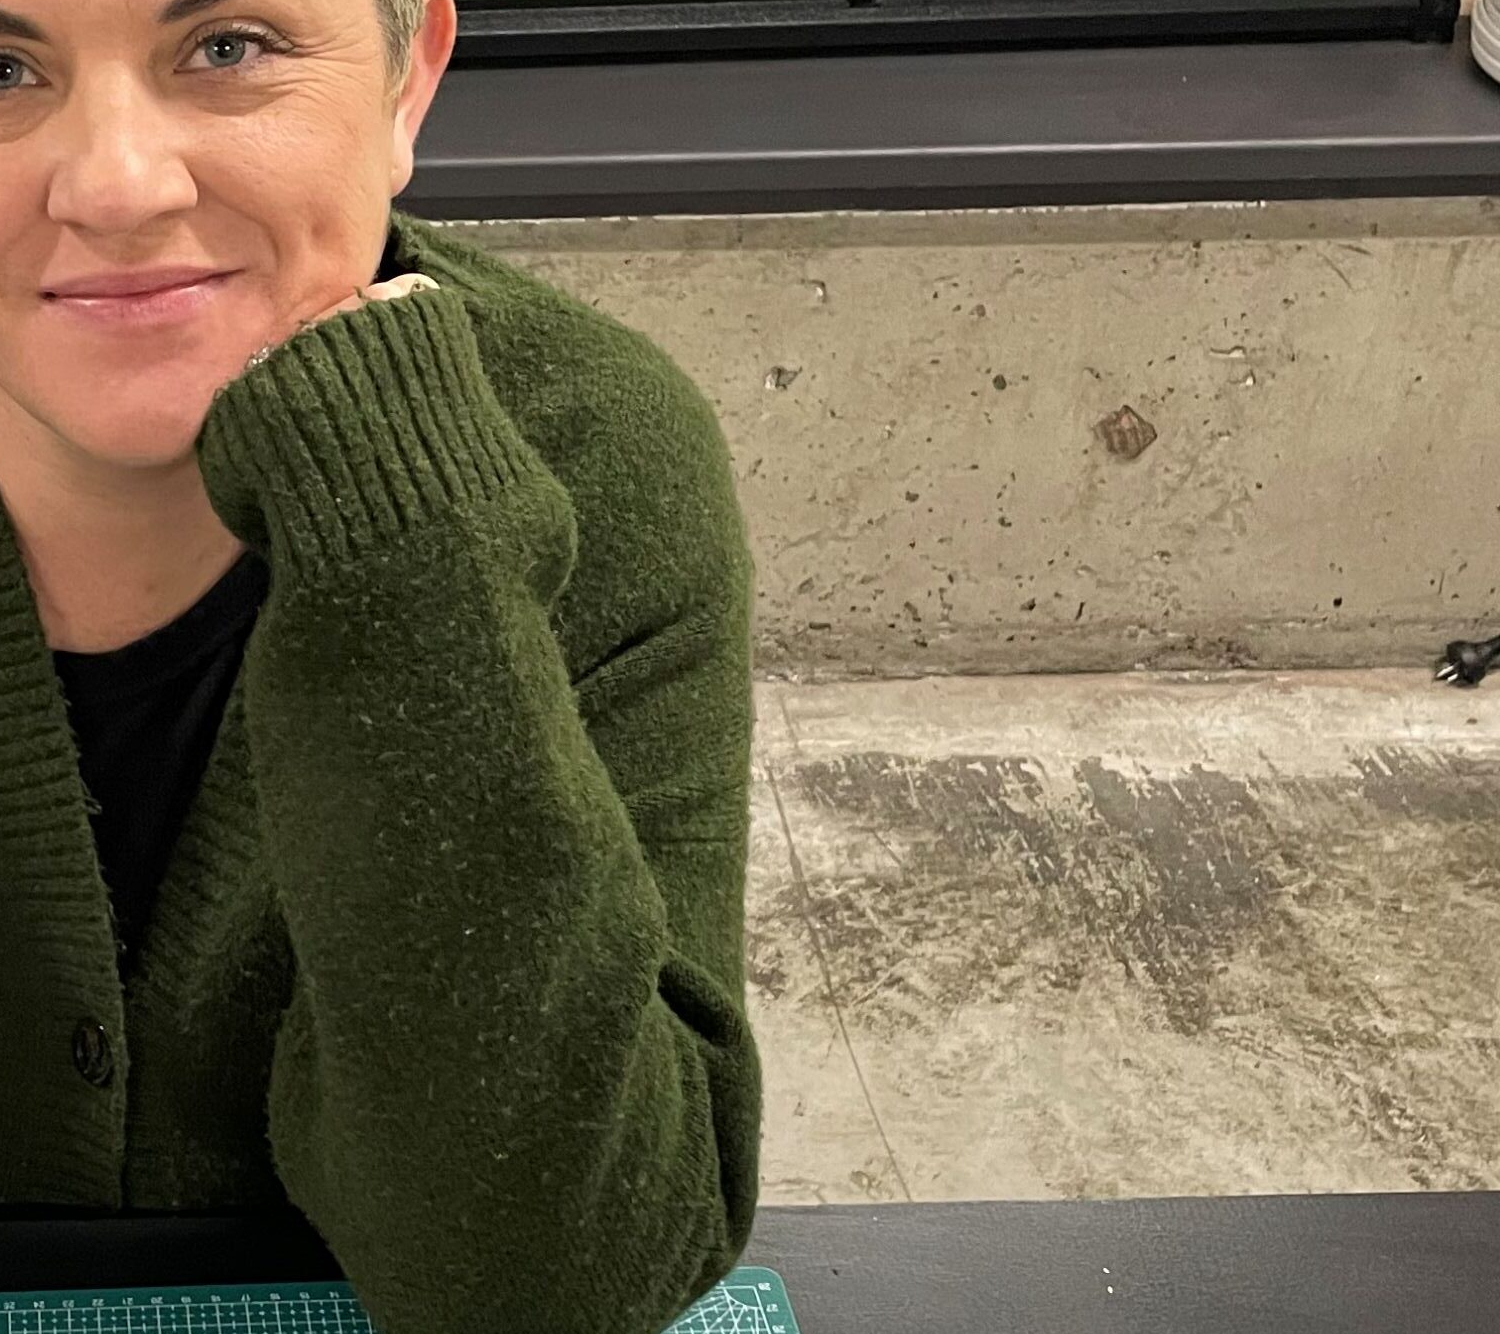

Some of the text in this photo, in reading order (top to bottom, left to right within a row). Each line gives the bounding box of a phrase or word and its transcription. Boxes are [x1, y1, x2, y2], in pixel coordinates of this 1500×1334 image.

[758, 1283, 770, 1291] 28
[210, 1294, 221, 1302] 18
[241, 1293, 250, 1301] 17
[269, 1293, 280, 1301] 16
[299, 1291, 310, 1300] 15
[329, 1291, 340, 1299] 14
[62, 1299, 74, 1307] 23
[92, 1299, 104, 1307] 22
[122, 1297, 133, 1305] 21
[151, 1296, 163, 1304] 20
[181, 1295, 191, 1304] 19
[33, 1300, 44, 1308] 24
[766, 1303, 778, 1312] 27
[772, 1325, 785, 1334] 26
